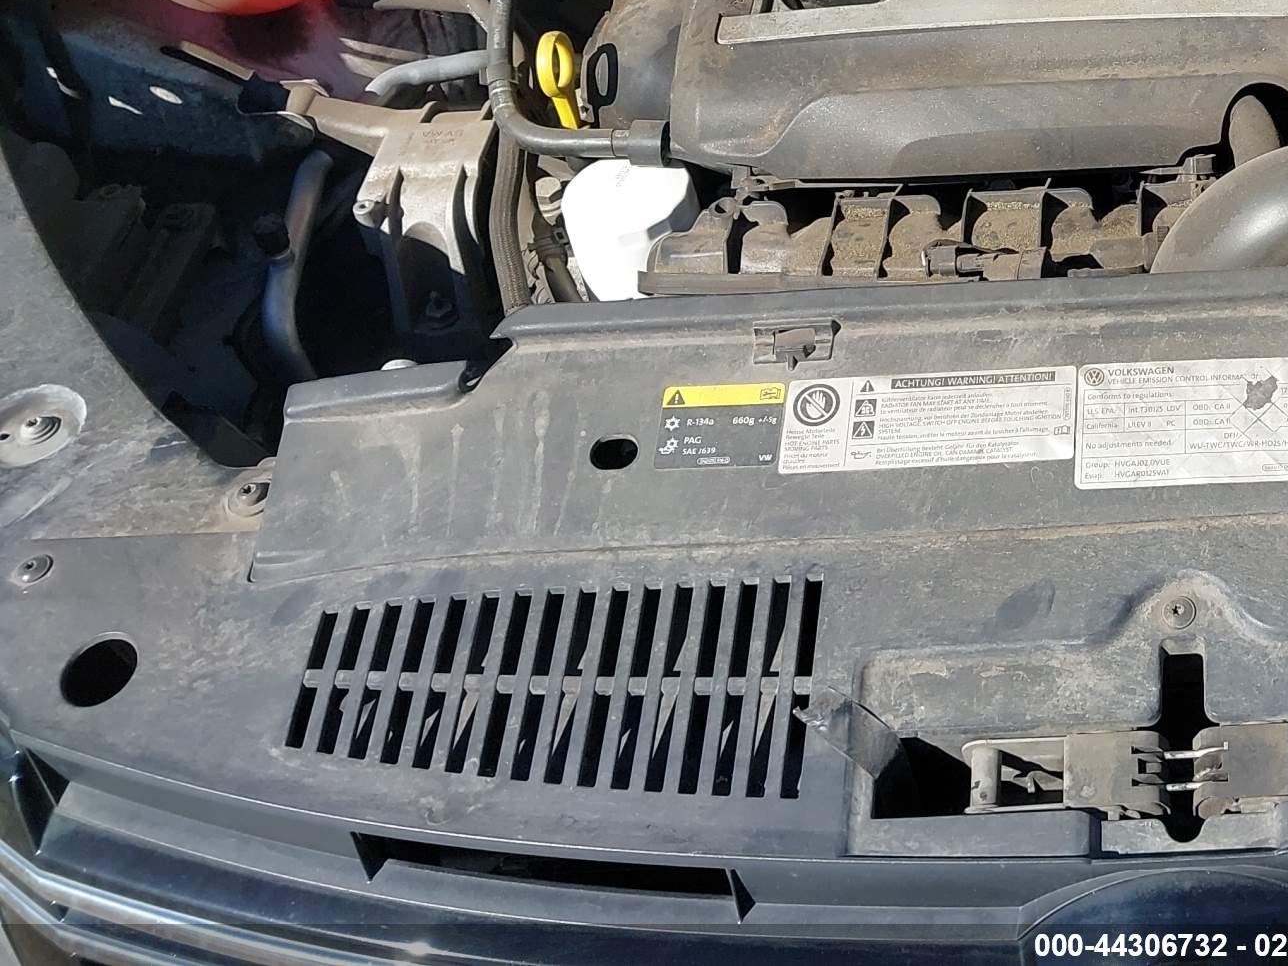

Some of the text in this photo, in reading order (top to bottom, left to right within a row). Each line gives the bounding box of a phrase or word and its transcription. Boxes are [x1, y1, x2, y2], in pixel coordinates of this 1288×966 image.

[1107, 366, 1175, 377] VOLKSWAGEN
[894, 372, 1053, 388] ACHTUNG! WARNING! ATTENTION!
[1138, 376, 1174, 384] EMISSION
[1175, 374, 1208, 382] CONTROL
[1087, 393, 1122, 401] Conforms
[686, 417, 715, 427] R-134a
[732, 416, 755, 427] 660g
[683, 436, 702, 444] PAG
[1098, 440, 1142, 450] adjustments
[682, 448, 697, 456] SAE
